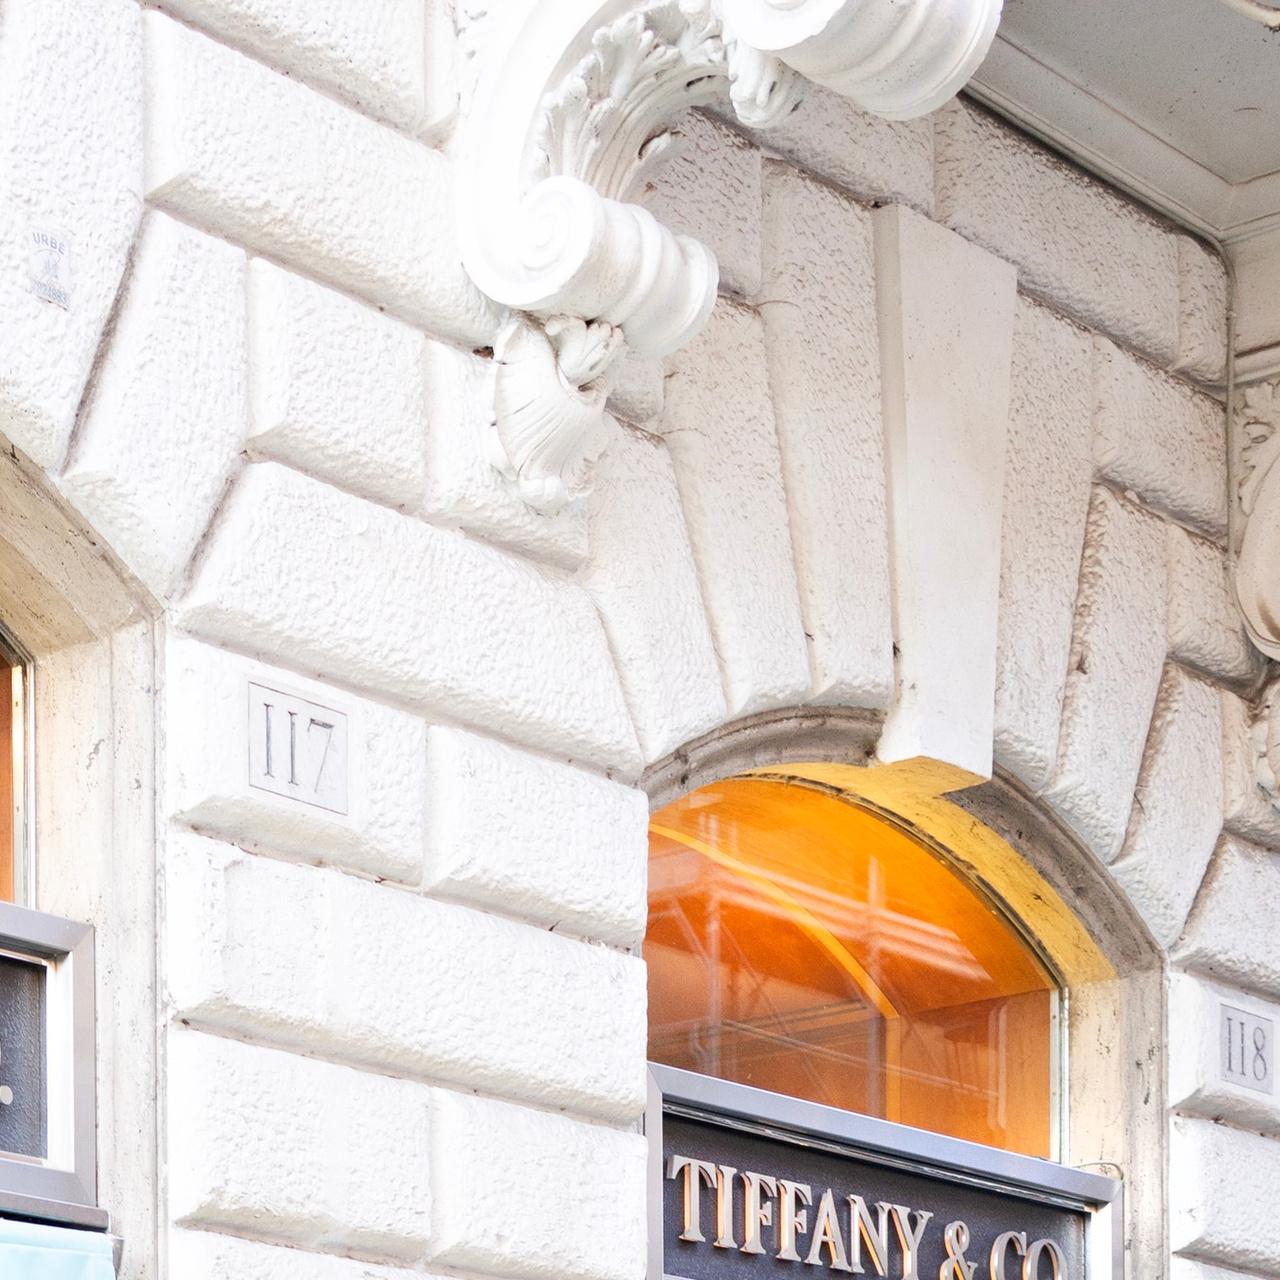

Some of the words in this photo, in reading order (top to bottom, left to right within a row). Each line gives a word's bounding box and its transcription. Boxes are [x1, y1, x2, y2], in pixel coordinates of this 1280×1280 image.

[32, 232, 66, 255] URBE
[263, 702, 336, 793] 117
[1226, 1017, 1268, 1081] 118
